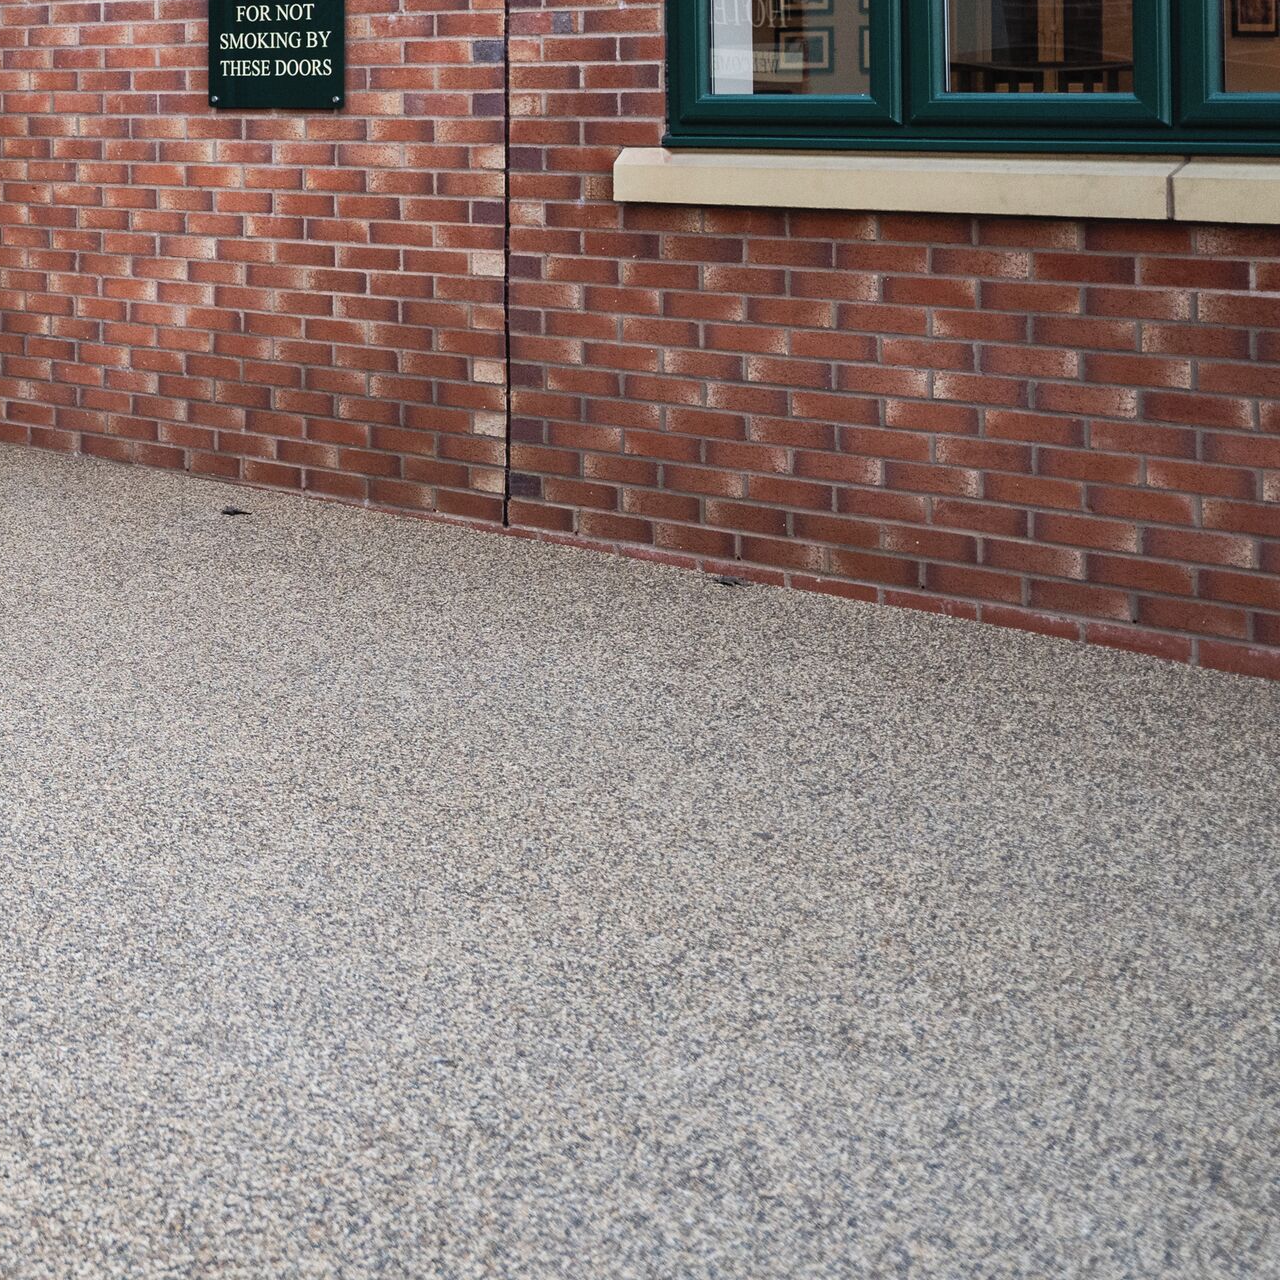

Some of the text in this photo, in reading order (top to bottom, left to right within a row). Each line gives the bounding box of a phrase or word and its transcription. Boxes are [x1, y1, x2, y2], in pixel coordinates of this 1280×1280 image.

[236, 3, 315, 22] FOR NOT
[219, 30, 332, 50] SMOKING BY
[219, 58, 333, 77] THESE DOORS
